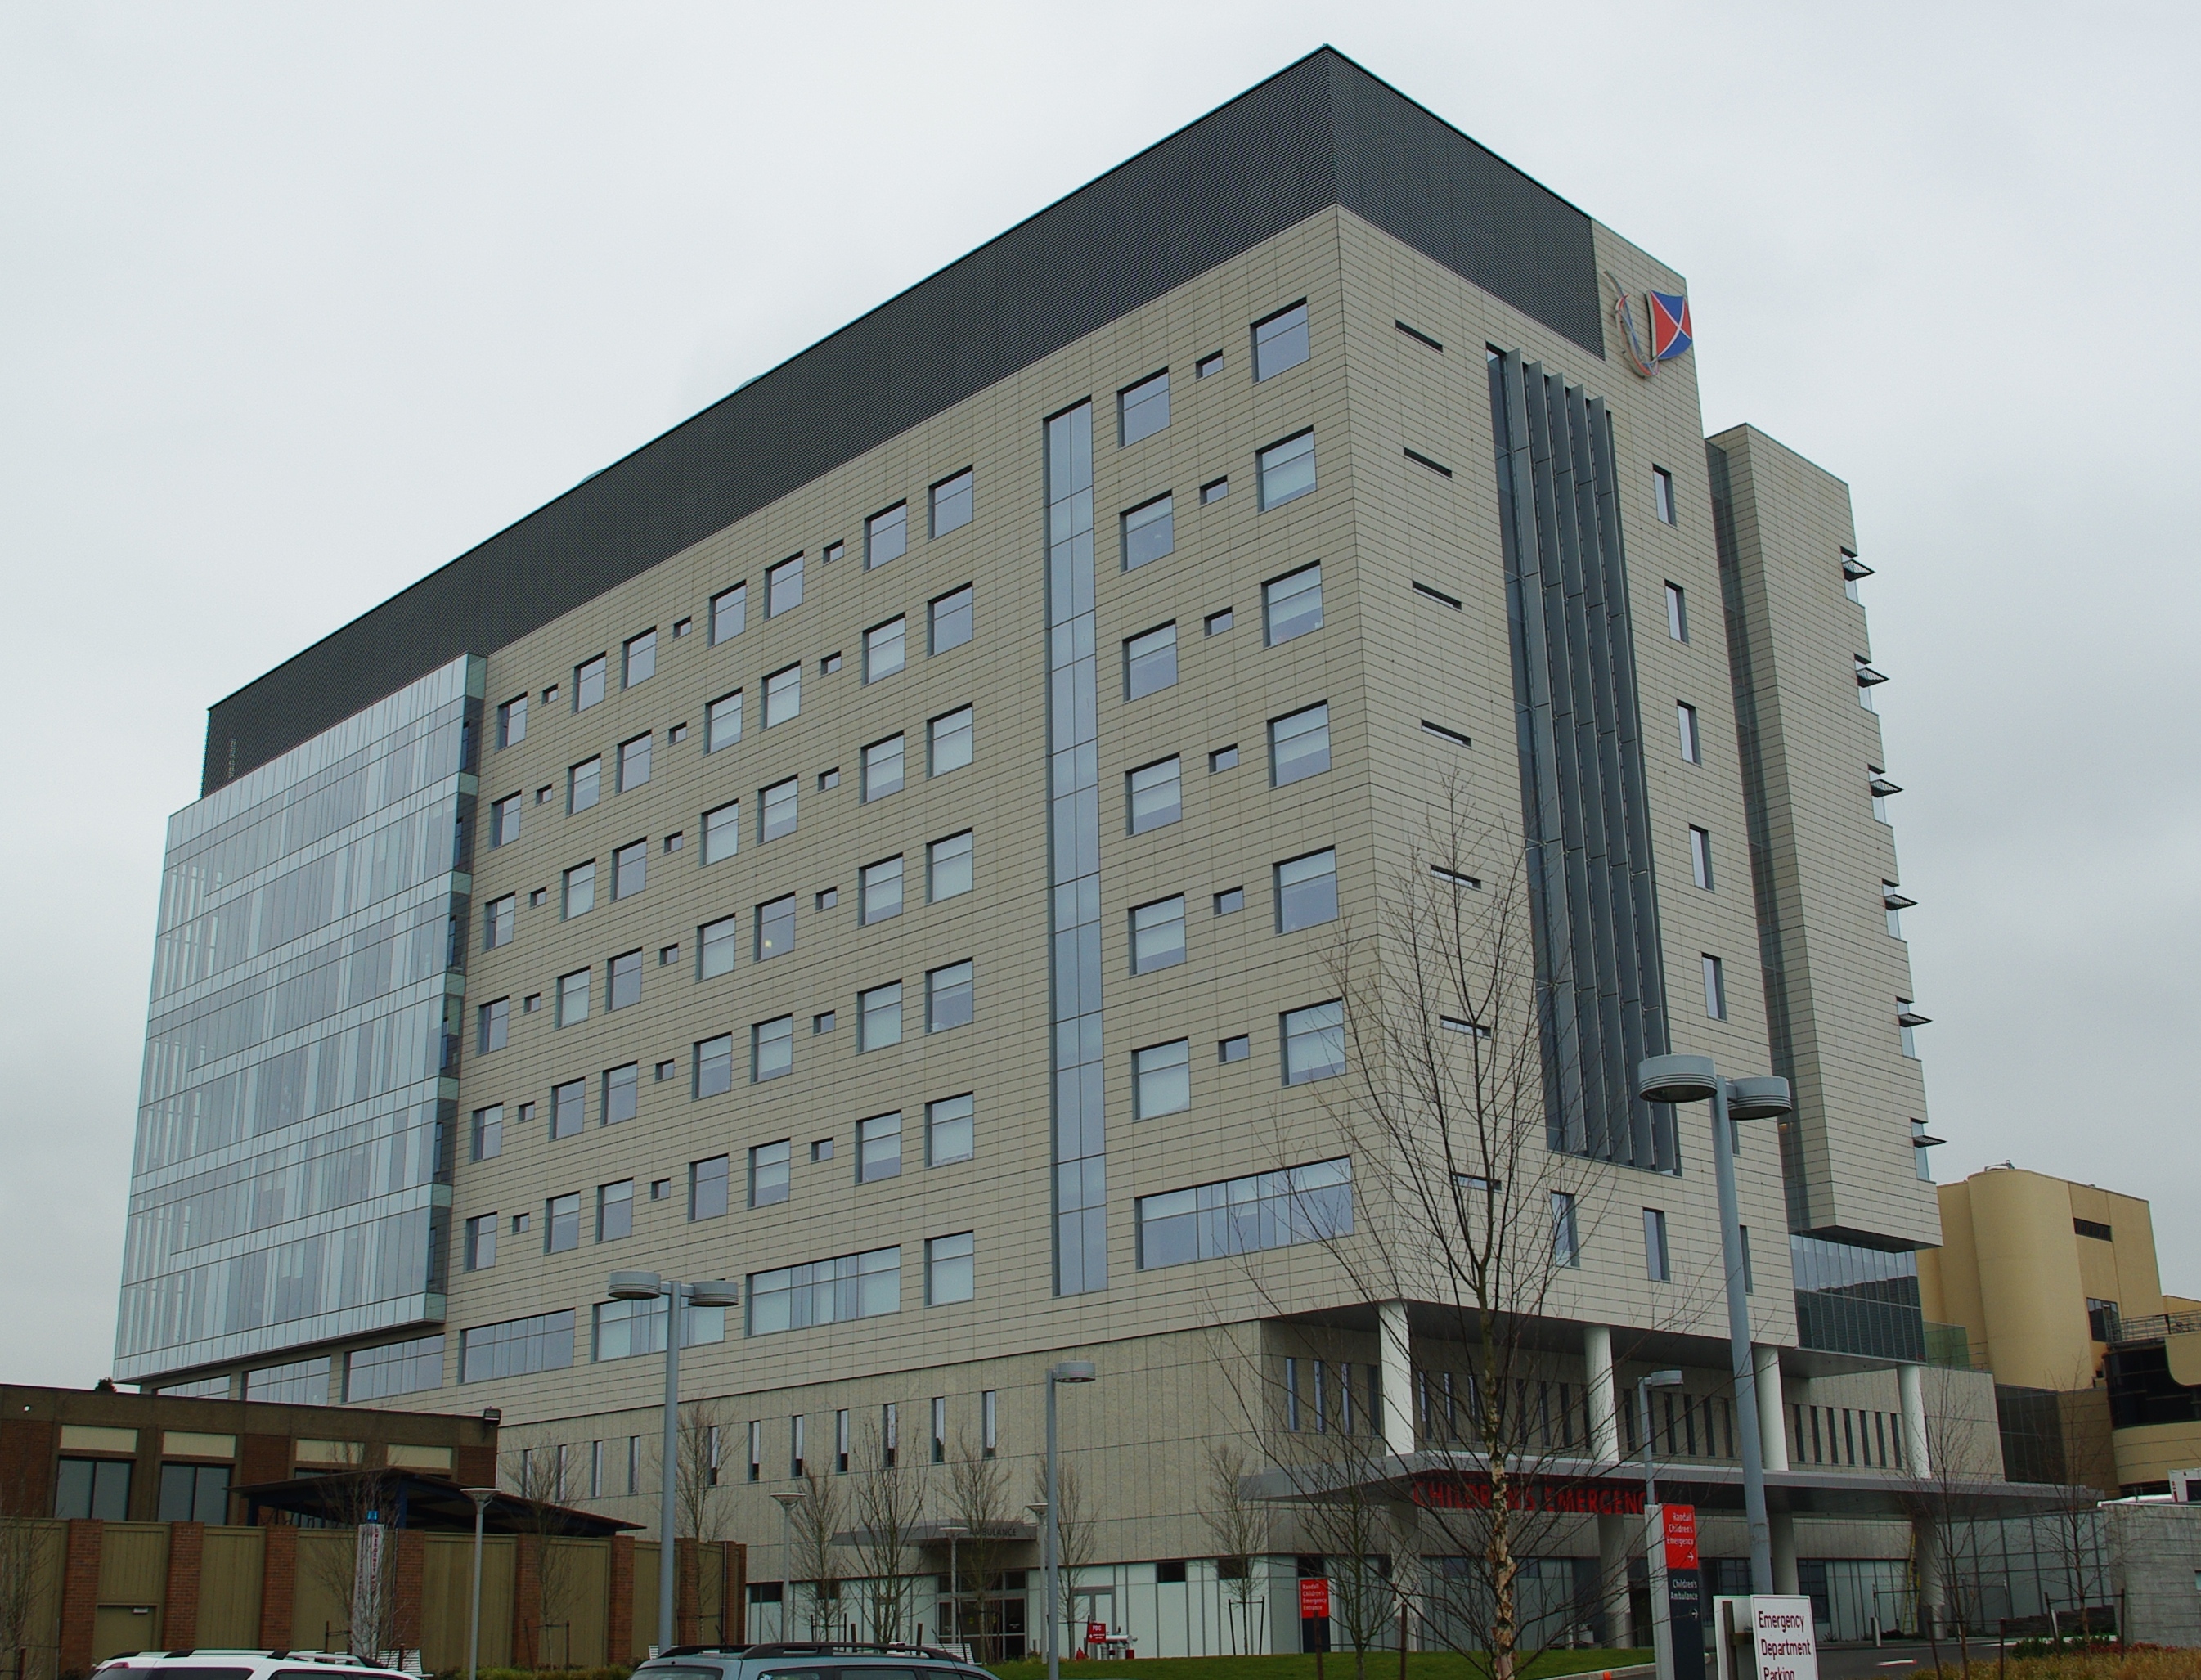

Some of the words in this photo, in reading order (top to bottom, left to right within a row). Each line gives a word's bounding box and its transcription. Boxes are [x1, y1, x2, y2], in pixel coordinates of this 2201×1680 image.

[1413, 1481, 1535, 1511] CHILDRNS
[1544, 1486, 1659, 1515] EMERGENC
[1673, 1512, 1692, 1521] Randall
[1669, 1524, 1693, 1533] Children's
[1666, 1538, 1694, 1547] Emergency
[1672, 1579, 1697, 1588] Children's
[1670, 1591, 1698, 1600] Ambulance
[1758, 1610, 1804, 1633] Emergency
[1760, 1638, 1811, 1660] Department
